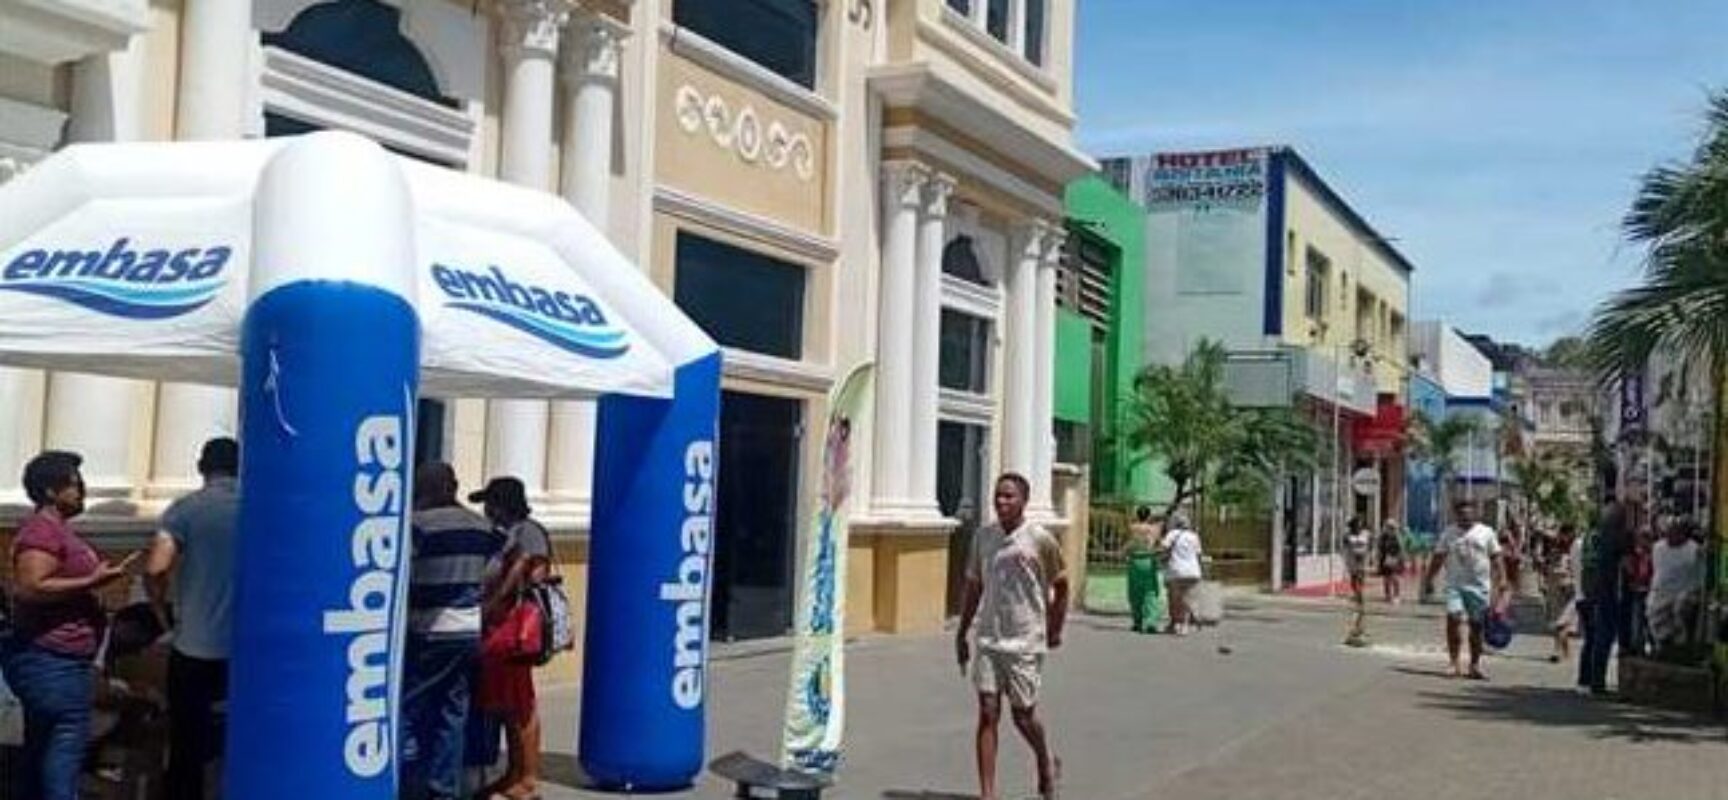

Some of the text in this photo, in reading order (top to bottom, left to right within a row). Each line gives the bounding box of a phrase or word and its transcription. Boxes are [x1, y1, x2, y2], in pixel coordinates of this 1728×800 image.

[1156, 151, 1253, 168] HOTEL
[3, 238, 231, 283] embasa
[432, 264, 607, 327] embasa
[323, 414, 403, 778] embasa
[660, 440, 713, 709] embasa
